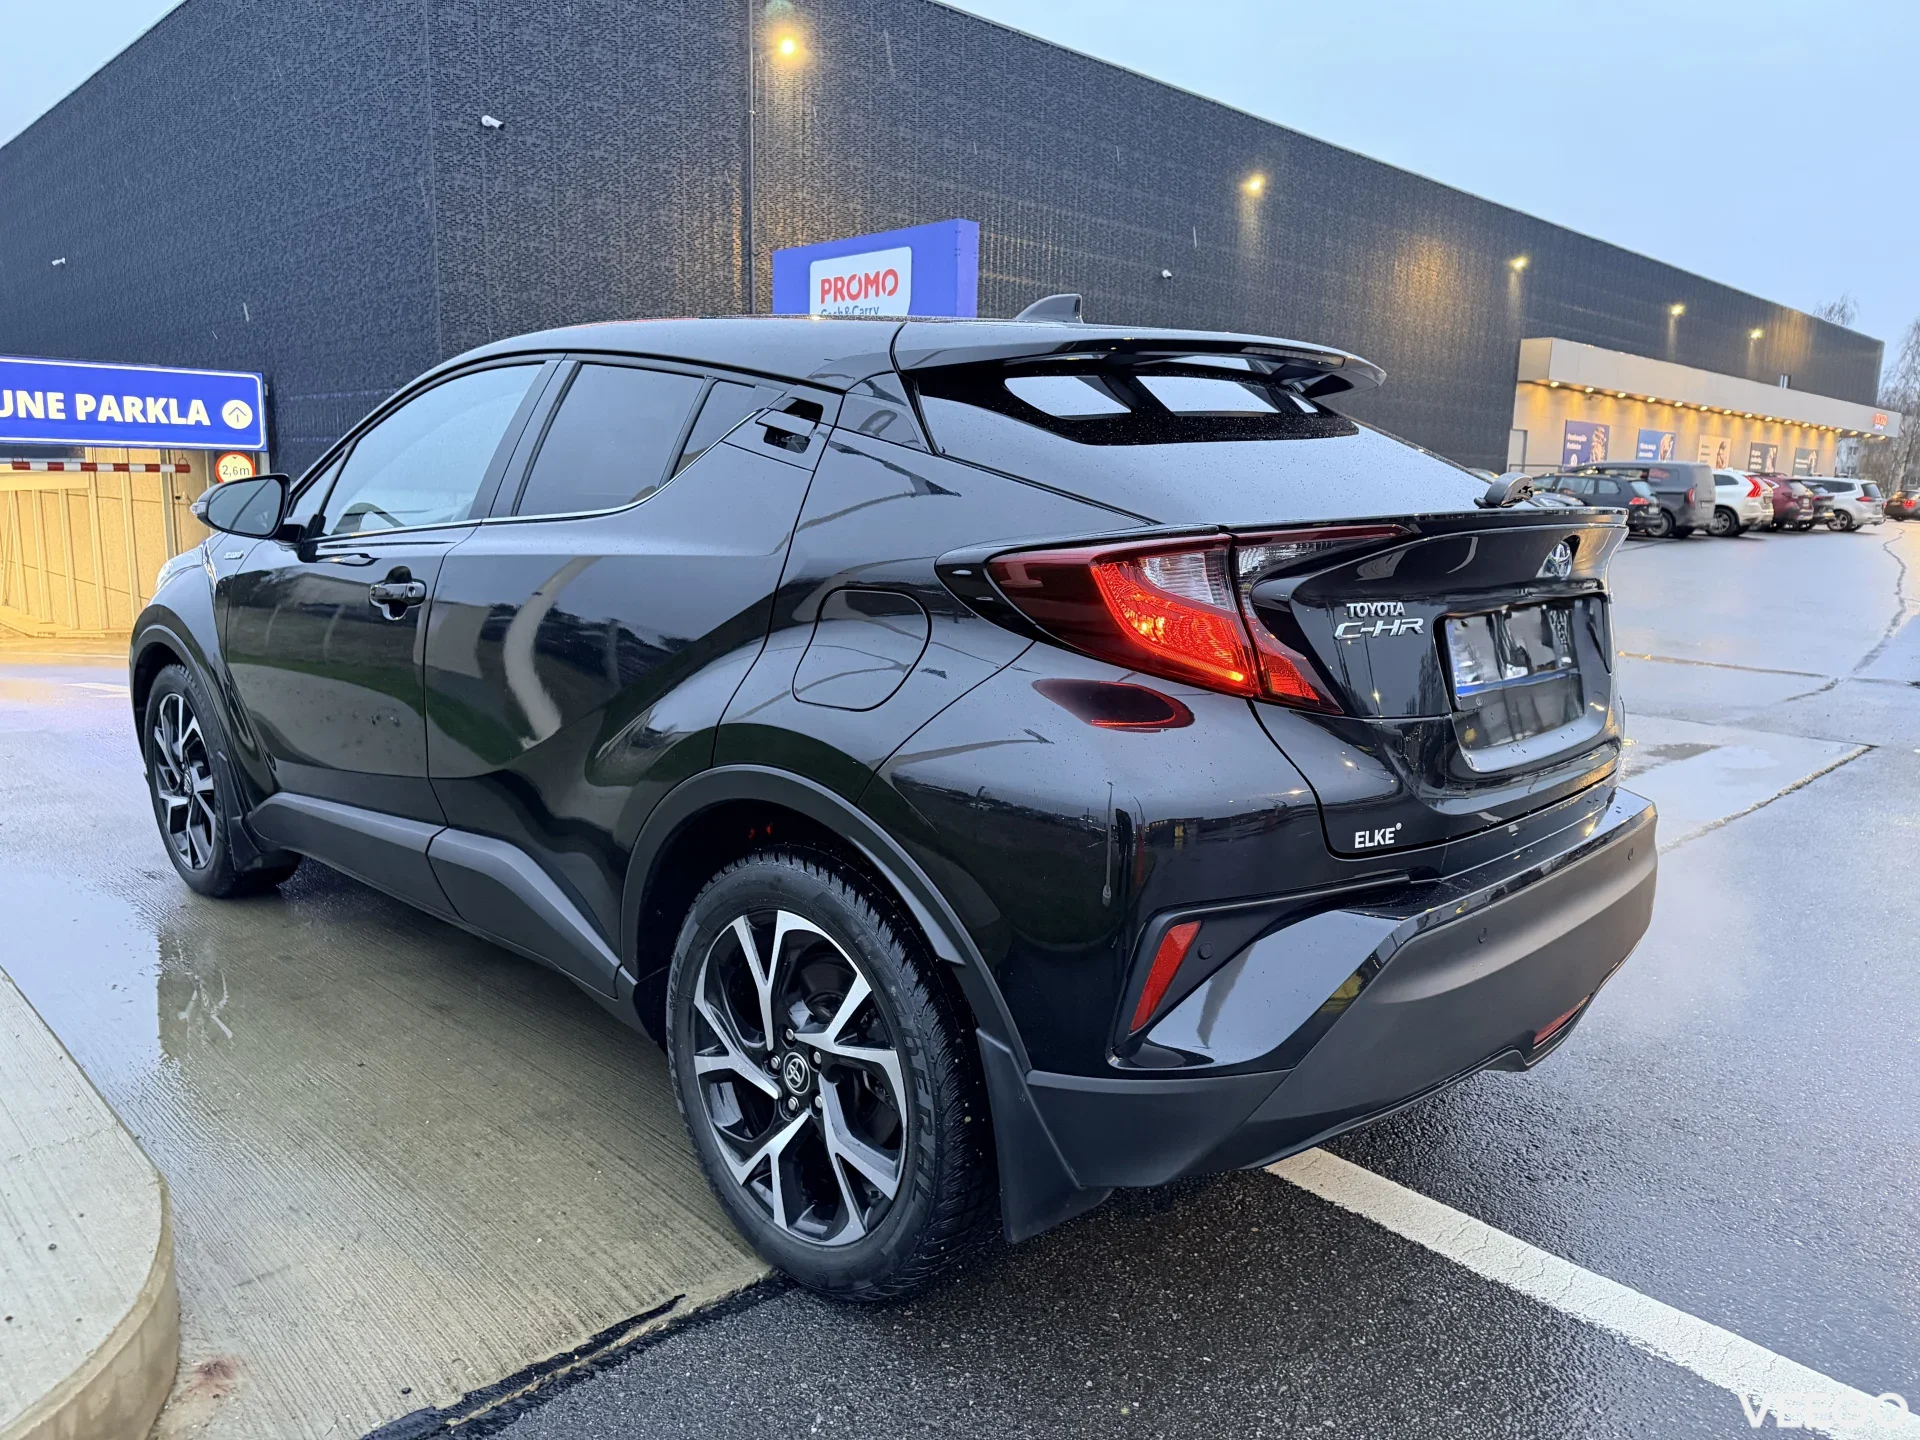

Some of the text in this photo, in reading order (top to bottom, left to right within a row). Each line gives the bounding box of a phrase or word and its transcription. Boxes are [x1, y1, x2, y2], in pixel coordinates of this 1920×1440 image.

[820, 268, 899, 304] PROMO
[820, 305, 880, 315] Ch&Carry
[75, 393, 211, 426] PARKLA
[222, 464, 250, 478] 2,6m
[1346, 601, 1407, 618] TOYOTA
[1334, 617, 1424, 640] C-HR
